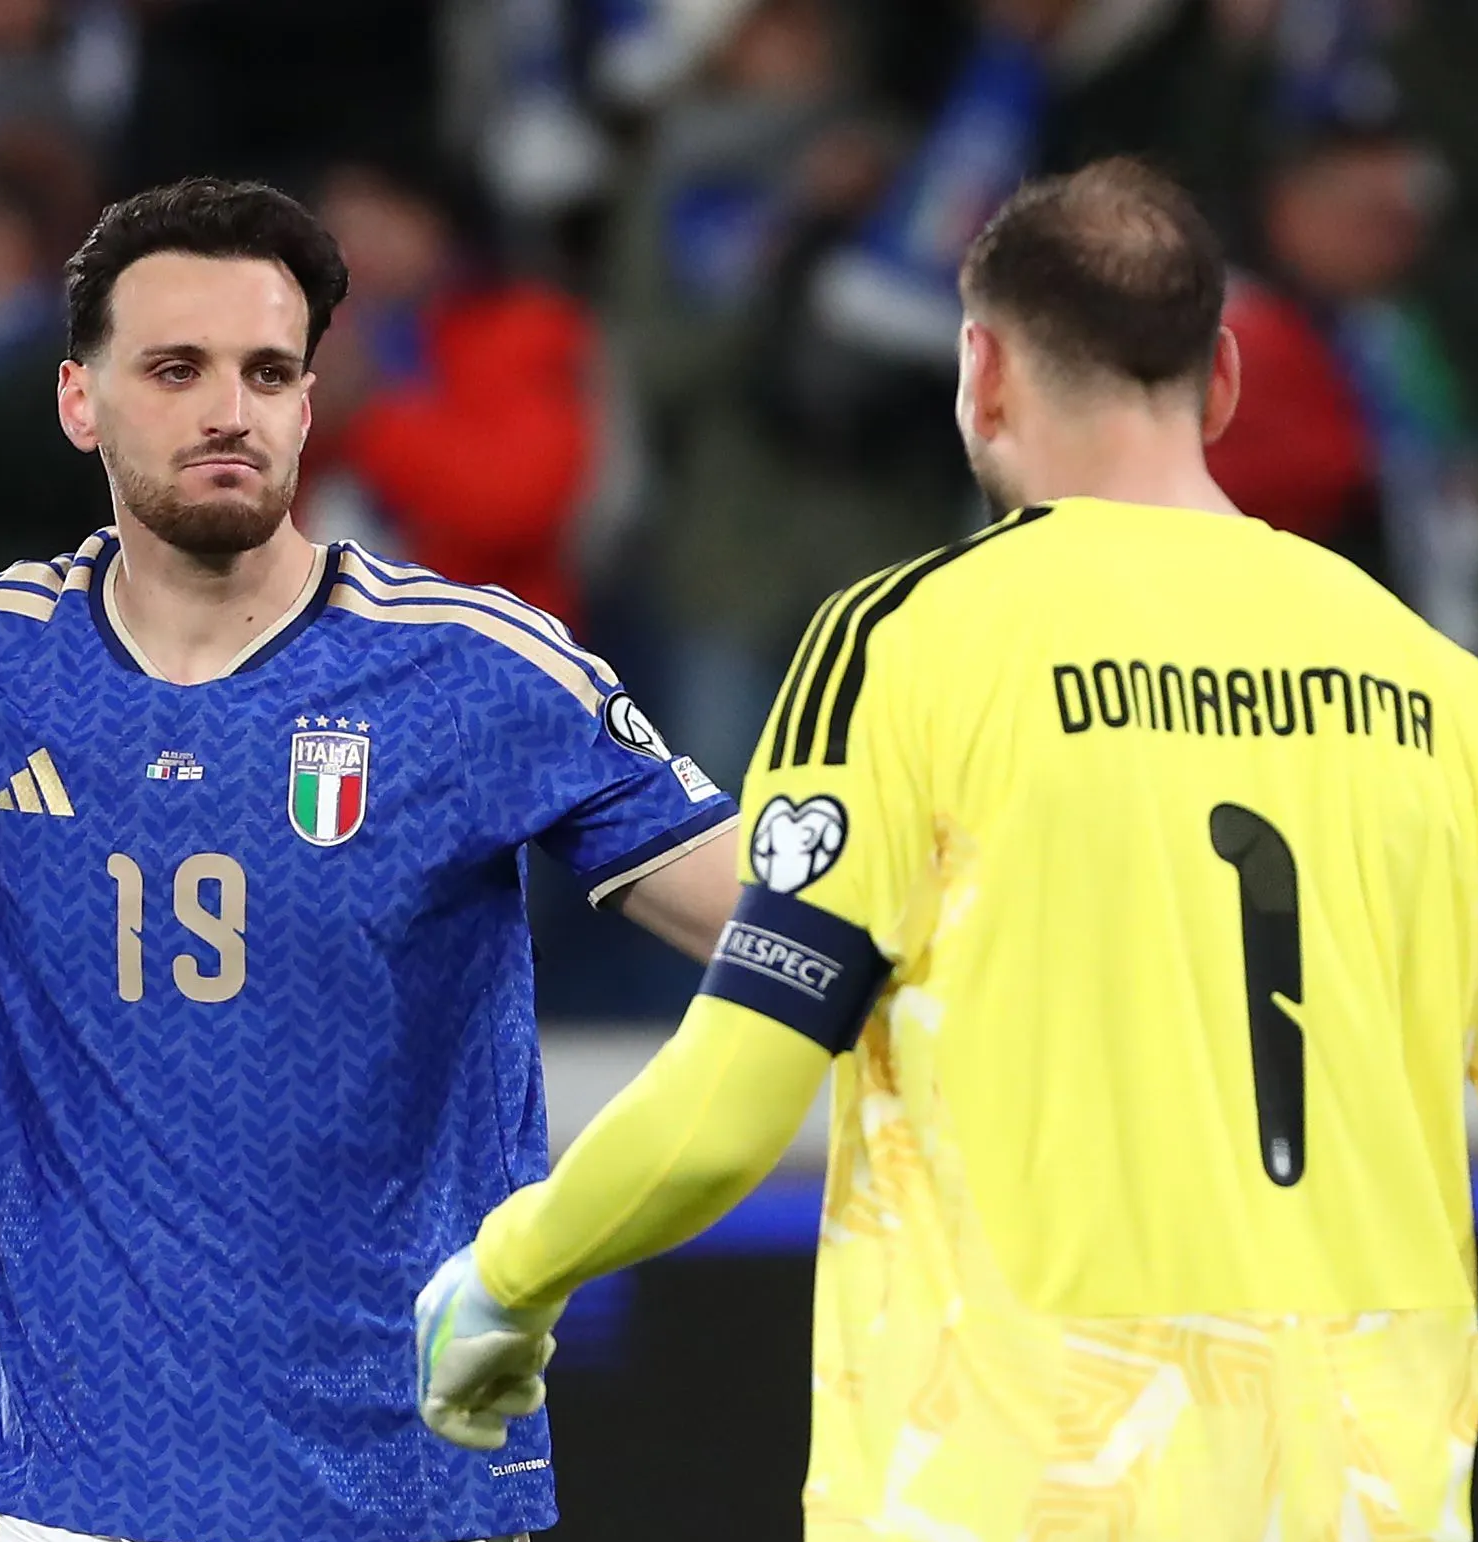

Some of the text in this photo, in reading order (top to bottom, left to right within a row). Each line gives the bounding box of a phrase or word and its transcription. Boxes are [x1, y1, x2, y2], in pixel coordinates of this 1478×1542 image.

[297, 739, 362, 767] ITALIA
[1051, 659, 1435, 757] DONNARUMMA
[106, 852, 248, 1004] 19
[726, 930, 840, 993] RESPECT
[1208, 801, 1306, 1187] 1
